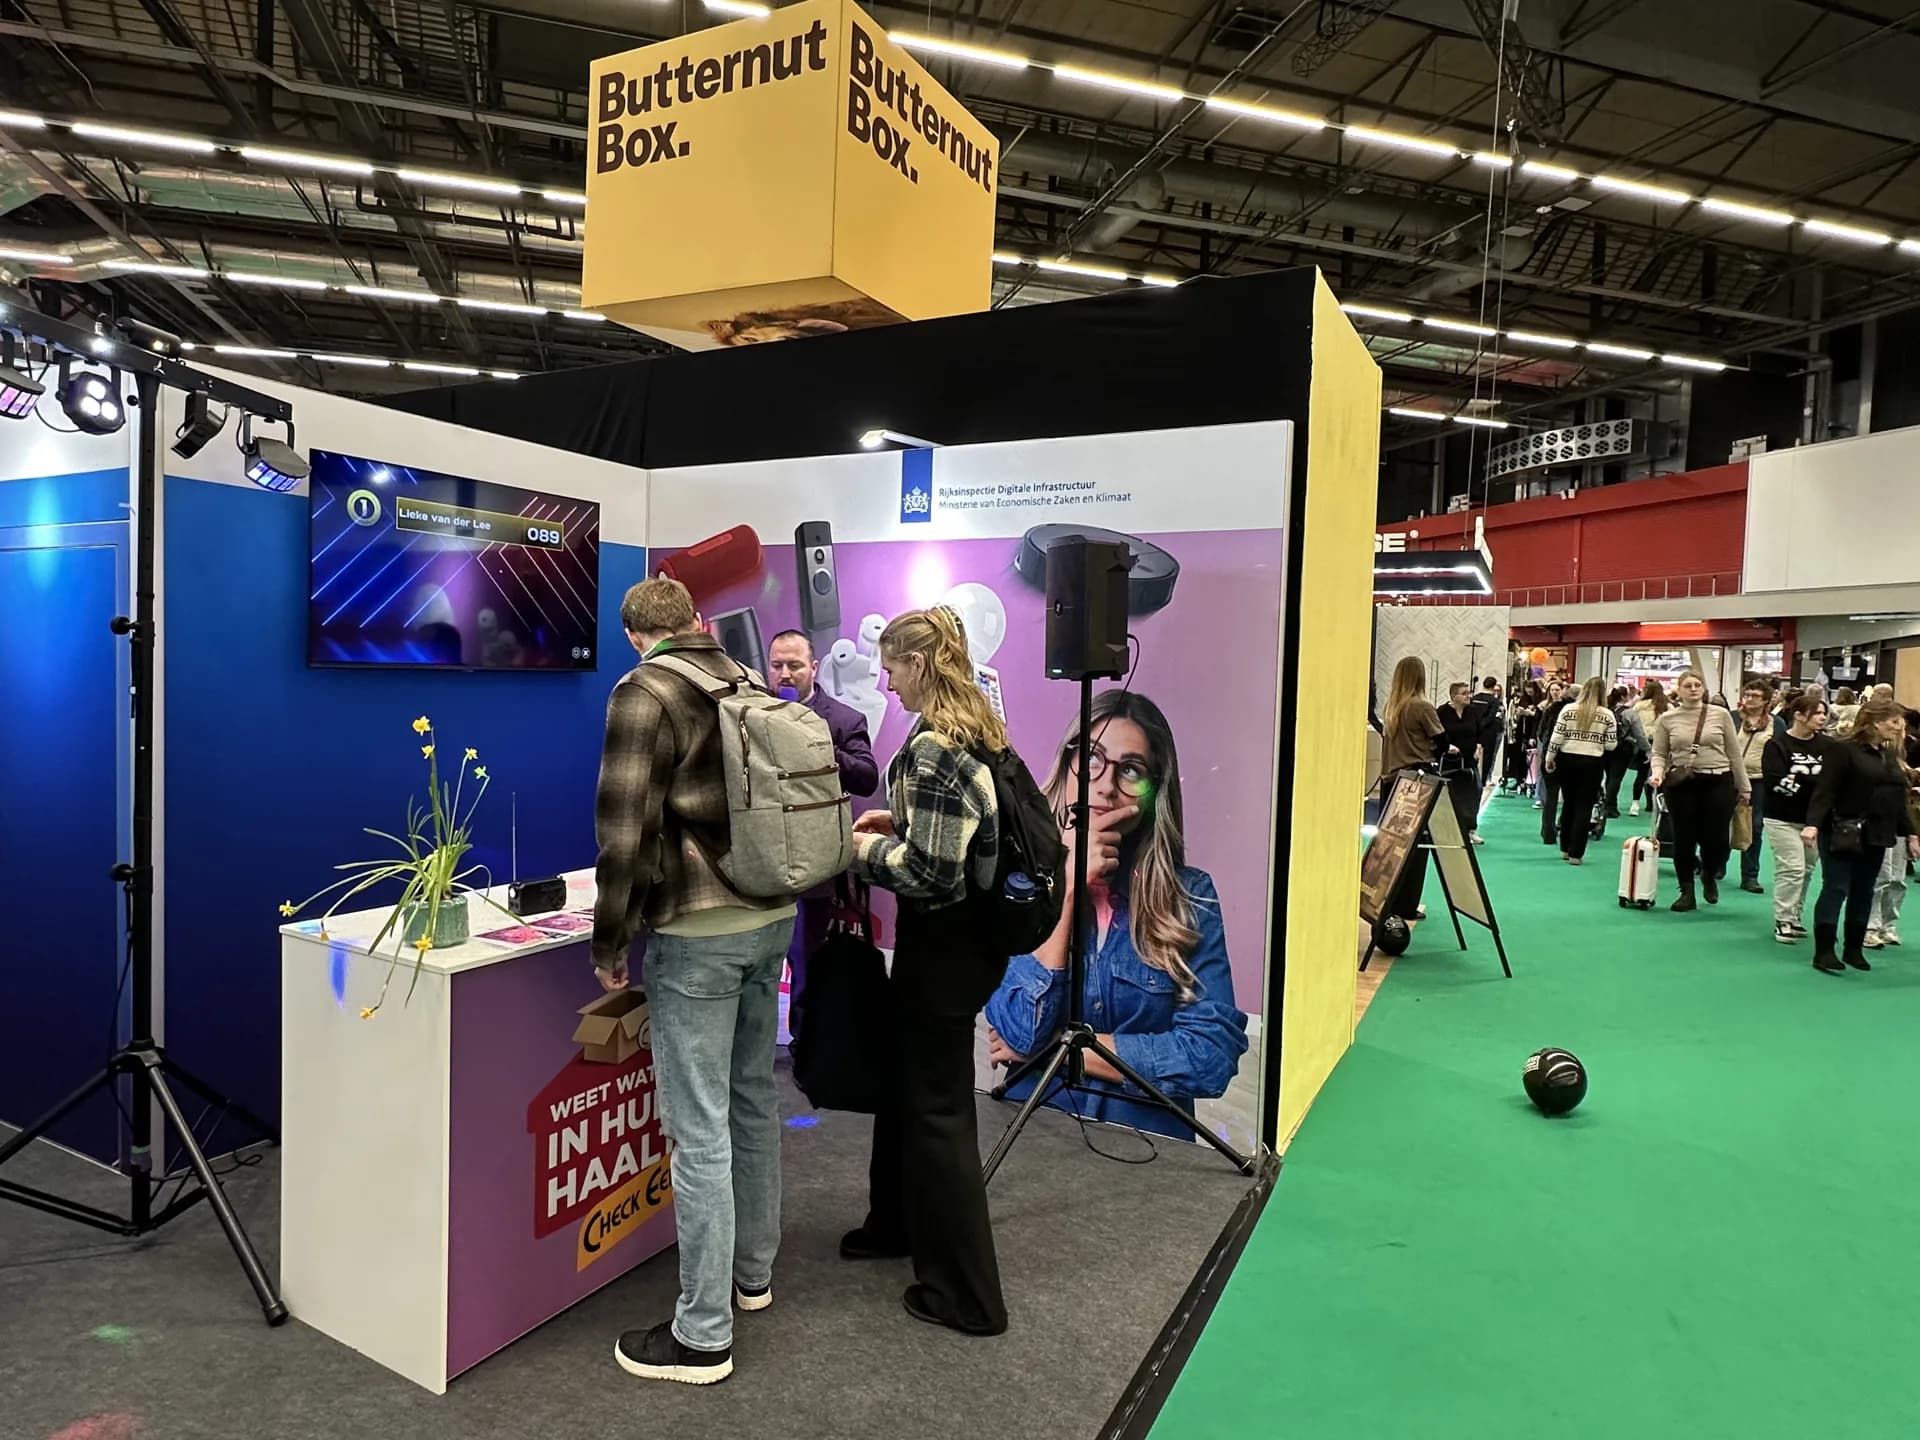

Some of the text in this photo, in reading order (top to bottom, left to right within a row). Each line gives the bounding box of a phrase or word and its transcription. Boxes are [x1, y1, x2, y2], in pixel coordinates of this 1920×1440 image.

[598, 19, 827, 123] Butternut
[848, 78, 919, 185] Box.
[849, 20, 993, 194] Butternut
[597, 121, 690, 175] Box.
[359, 498, 368, 517] 1
[939, 480, 1097, 498] Rijksinspectie Digitale Infrastructuur
[939, 492, 1132, 510] Ministerie van Economische Zaken en Klimaat
[398, 507, 492, 531] Lieke van der Lee
[527, 526, 560, 545] 089
[550, 1066, 656, 1123] WEET WAT
[548, 1119, 590, 1169] IN
